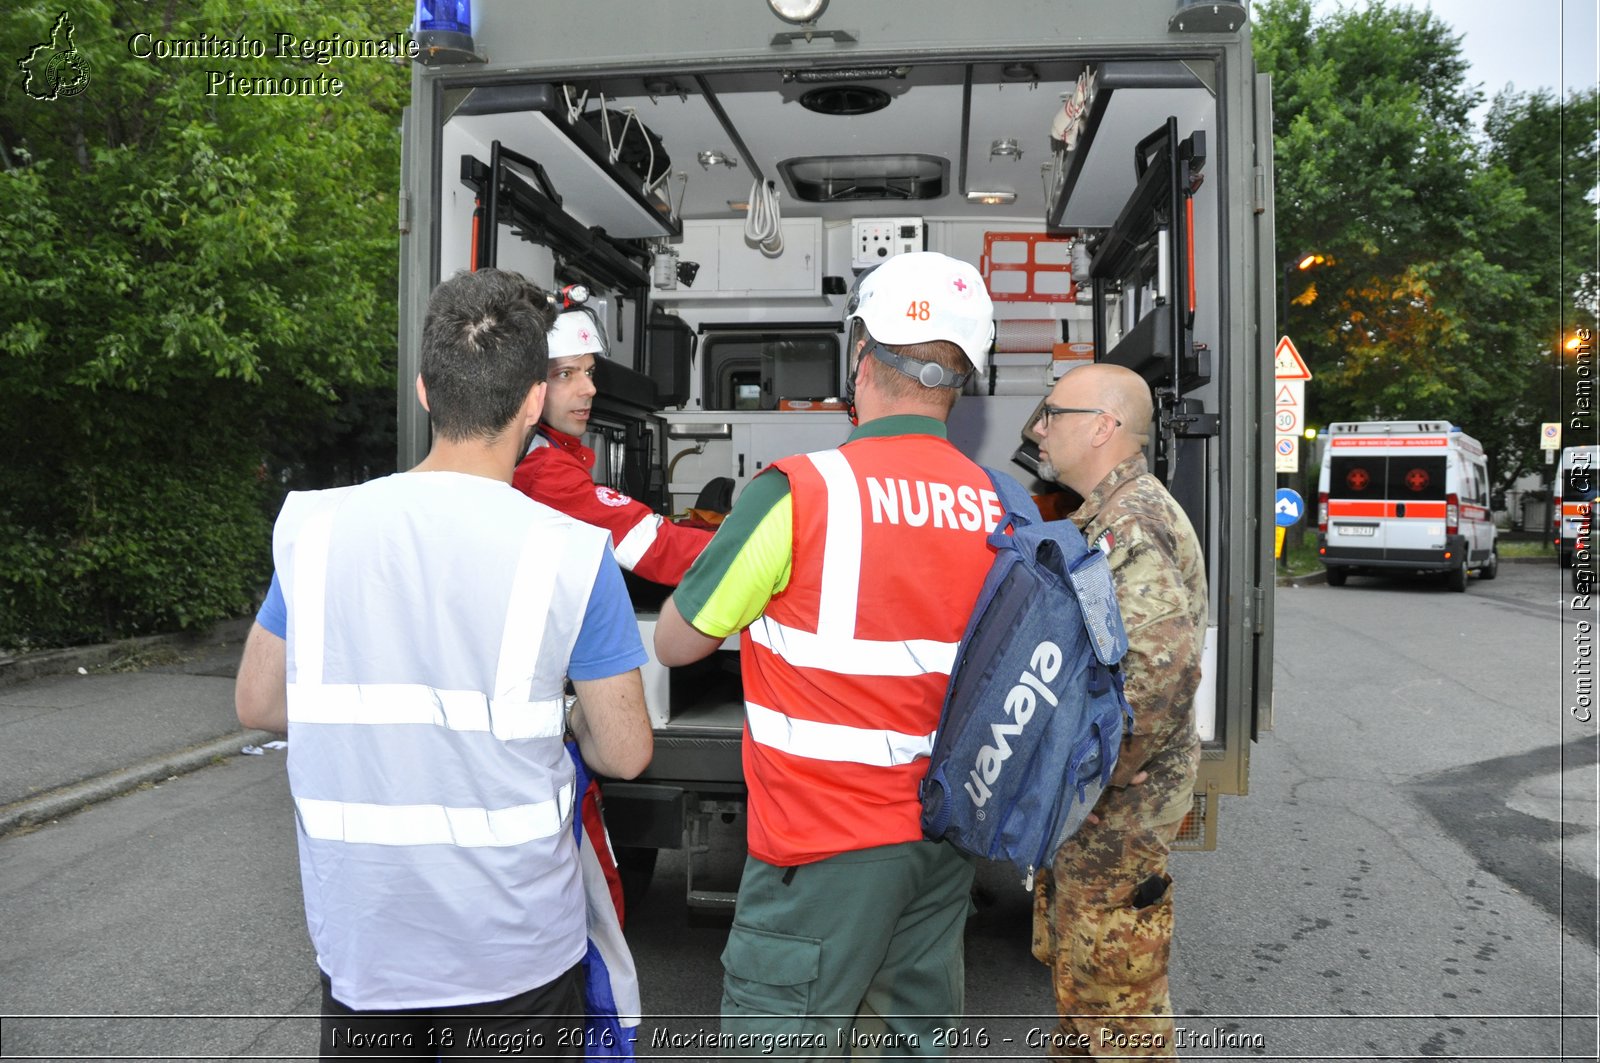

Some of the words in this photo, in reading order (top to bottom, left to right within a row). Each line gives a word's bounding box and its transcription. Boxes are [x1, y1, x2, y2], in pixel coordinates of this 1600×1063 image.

[906, 300, 930, 321] 48
[1278, 415, 1292, 426] 30
[866, 477, 1004, 534] NURSE
[964, 641, 1063, 807] eleven
